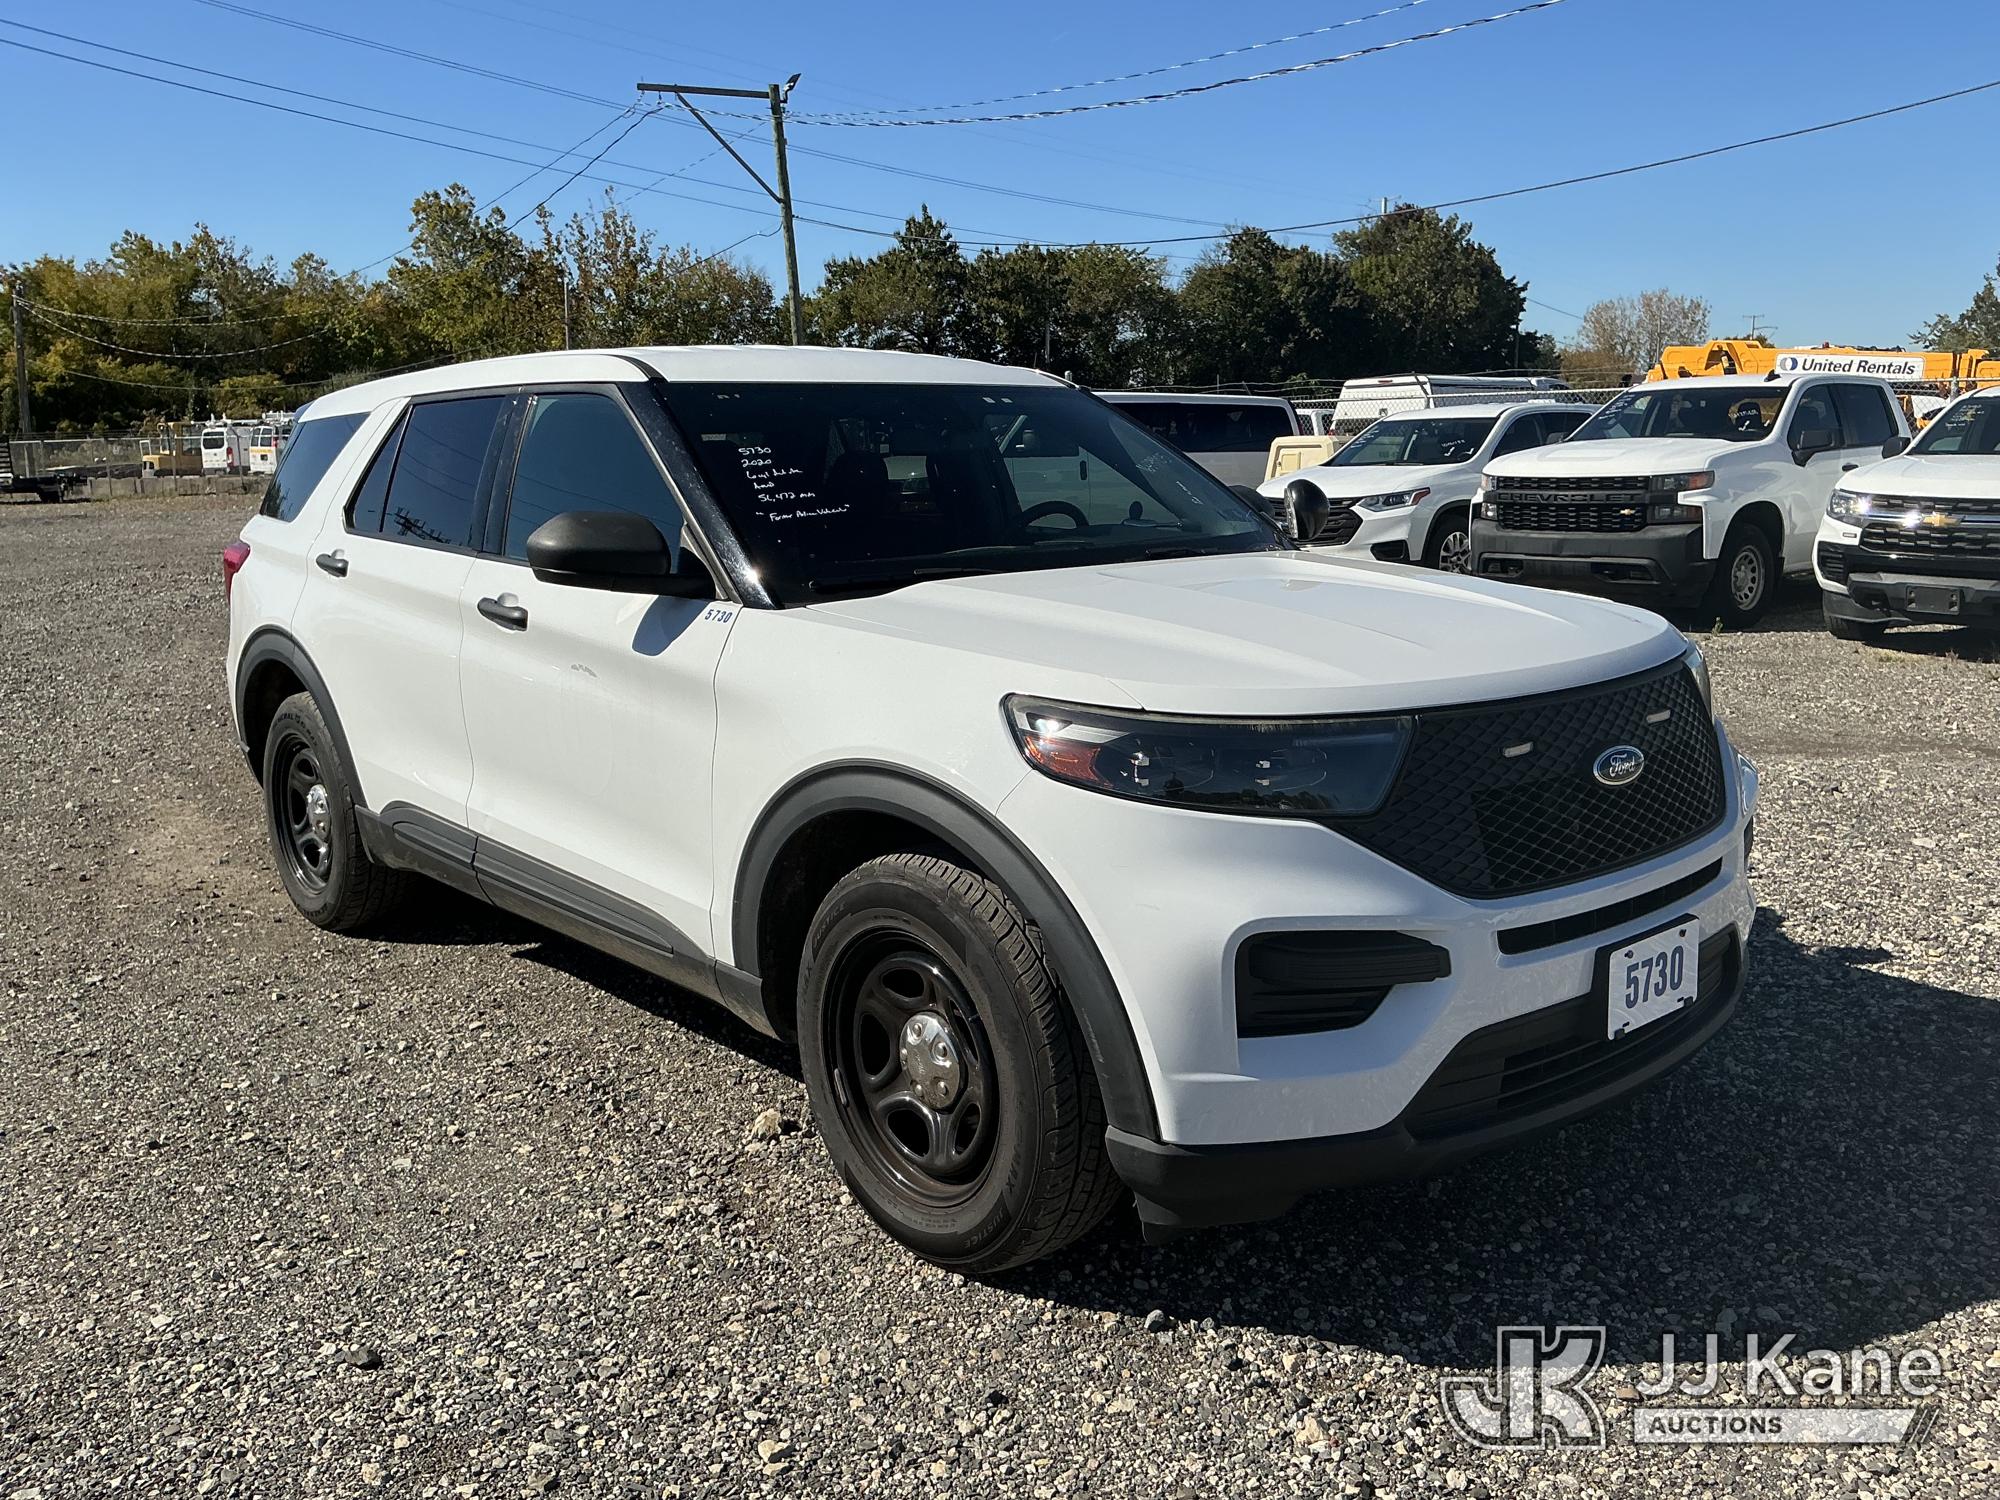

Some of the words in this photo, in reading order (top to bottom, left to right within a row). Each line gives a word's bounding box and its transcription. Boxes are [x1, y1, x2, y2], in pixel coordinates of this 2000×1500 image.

[1801, 358, 1854, 373] United
[1856, 359, 1916, 375] Rentals
[738, 446, 772, 455] 5730
[741, 459, 772, 468] 2020
[1498, 491, 1644, 504] CHEVROLET
[704, 608, 733, 624] 5730
[1609, 752, 1636, 778] Ford
[1624, 945, 1685, 1010] 5730
